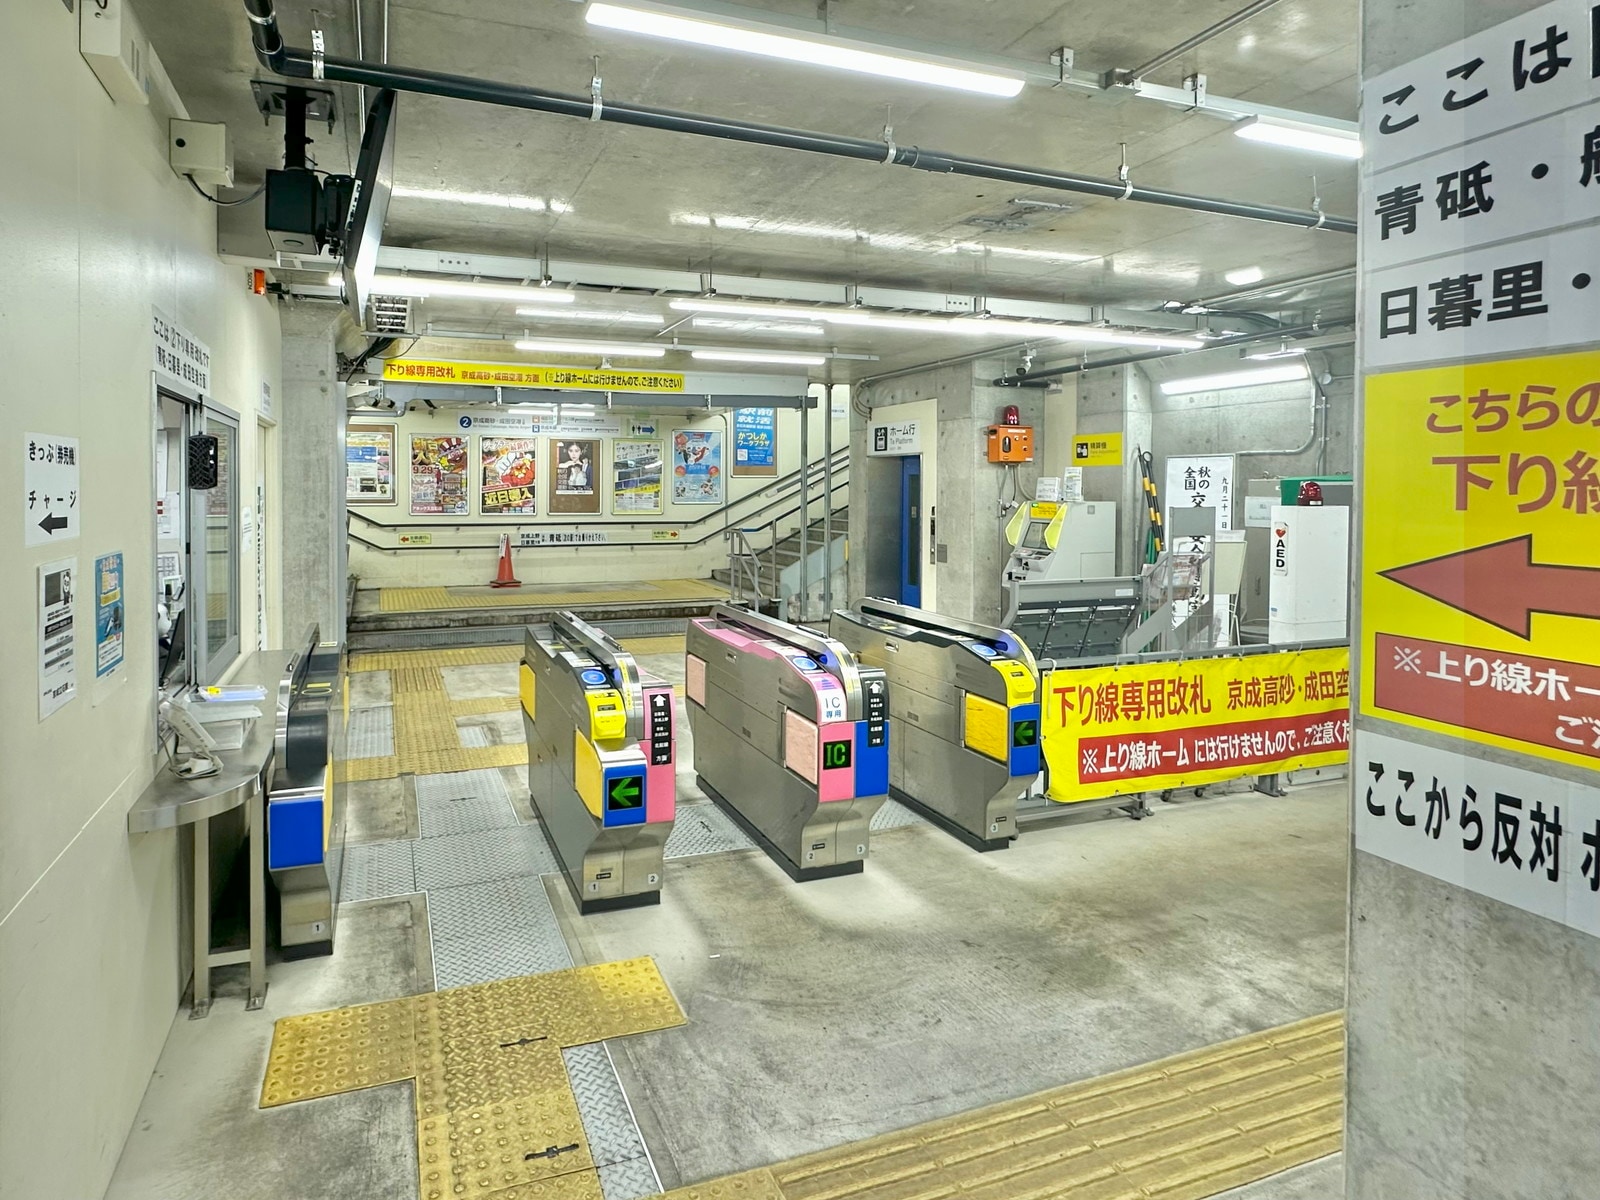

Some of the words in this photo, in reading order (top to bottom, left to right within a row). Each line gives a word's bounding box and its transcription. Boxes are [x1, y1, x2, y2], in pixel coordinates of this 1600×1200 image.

[1379, 25, 1572, 134] ここは
[386, 363, 456, 379] 下り線専用改札
[738, 431, 768, 441] かつしか
[890, 424, 916, 436] ホーム行
[1184, 466, 1196, 491] 全国
[1198, 466, 1211, 489] 秋の
[29, 490, 77, 510] チャージ
[484, 487, 534, 505] 近日導入
[1276, 539, 1286, 568] AED
[1053, 674, 1212, 728] 下り線専用改札
[826, 710, 842, 719] 専用
[1555, 715, 1600, 750] ご
[826, 743, 846, 766] IC
[1366, 761, 1563, 882] ここから反対
